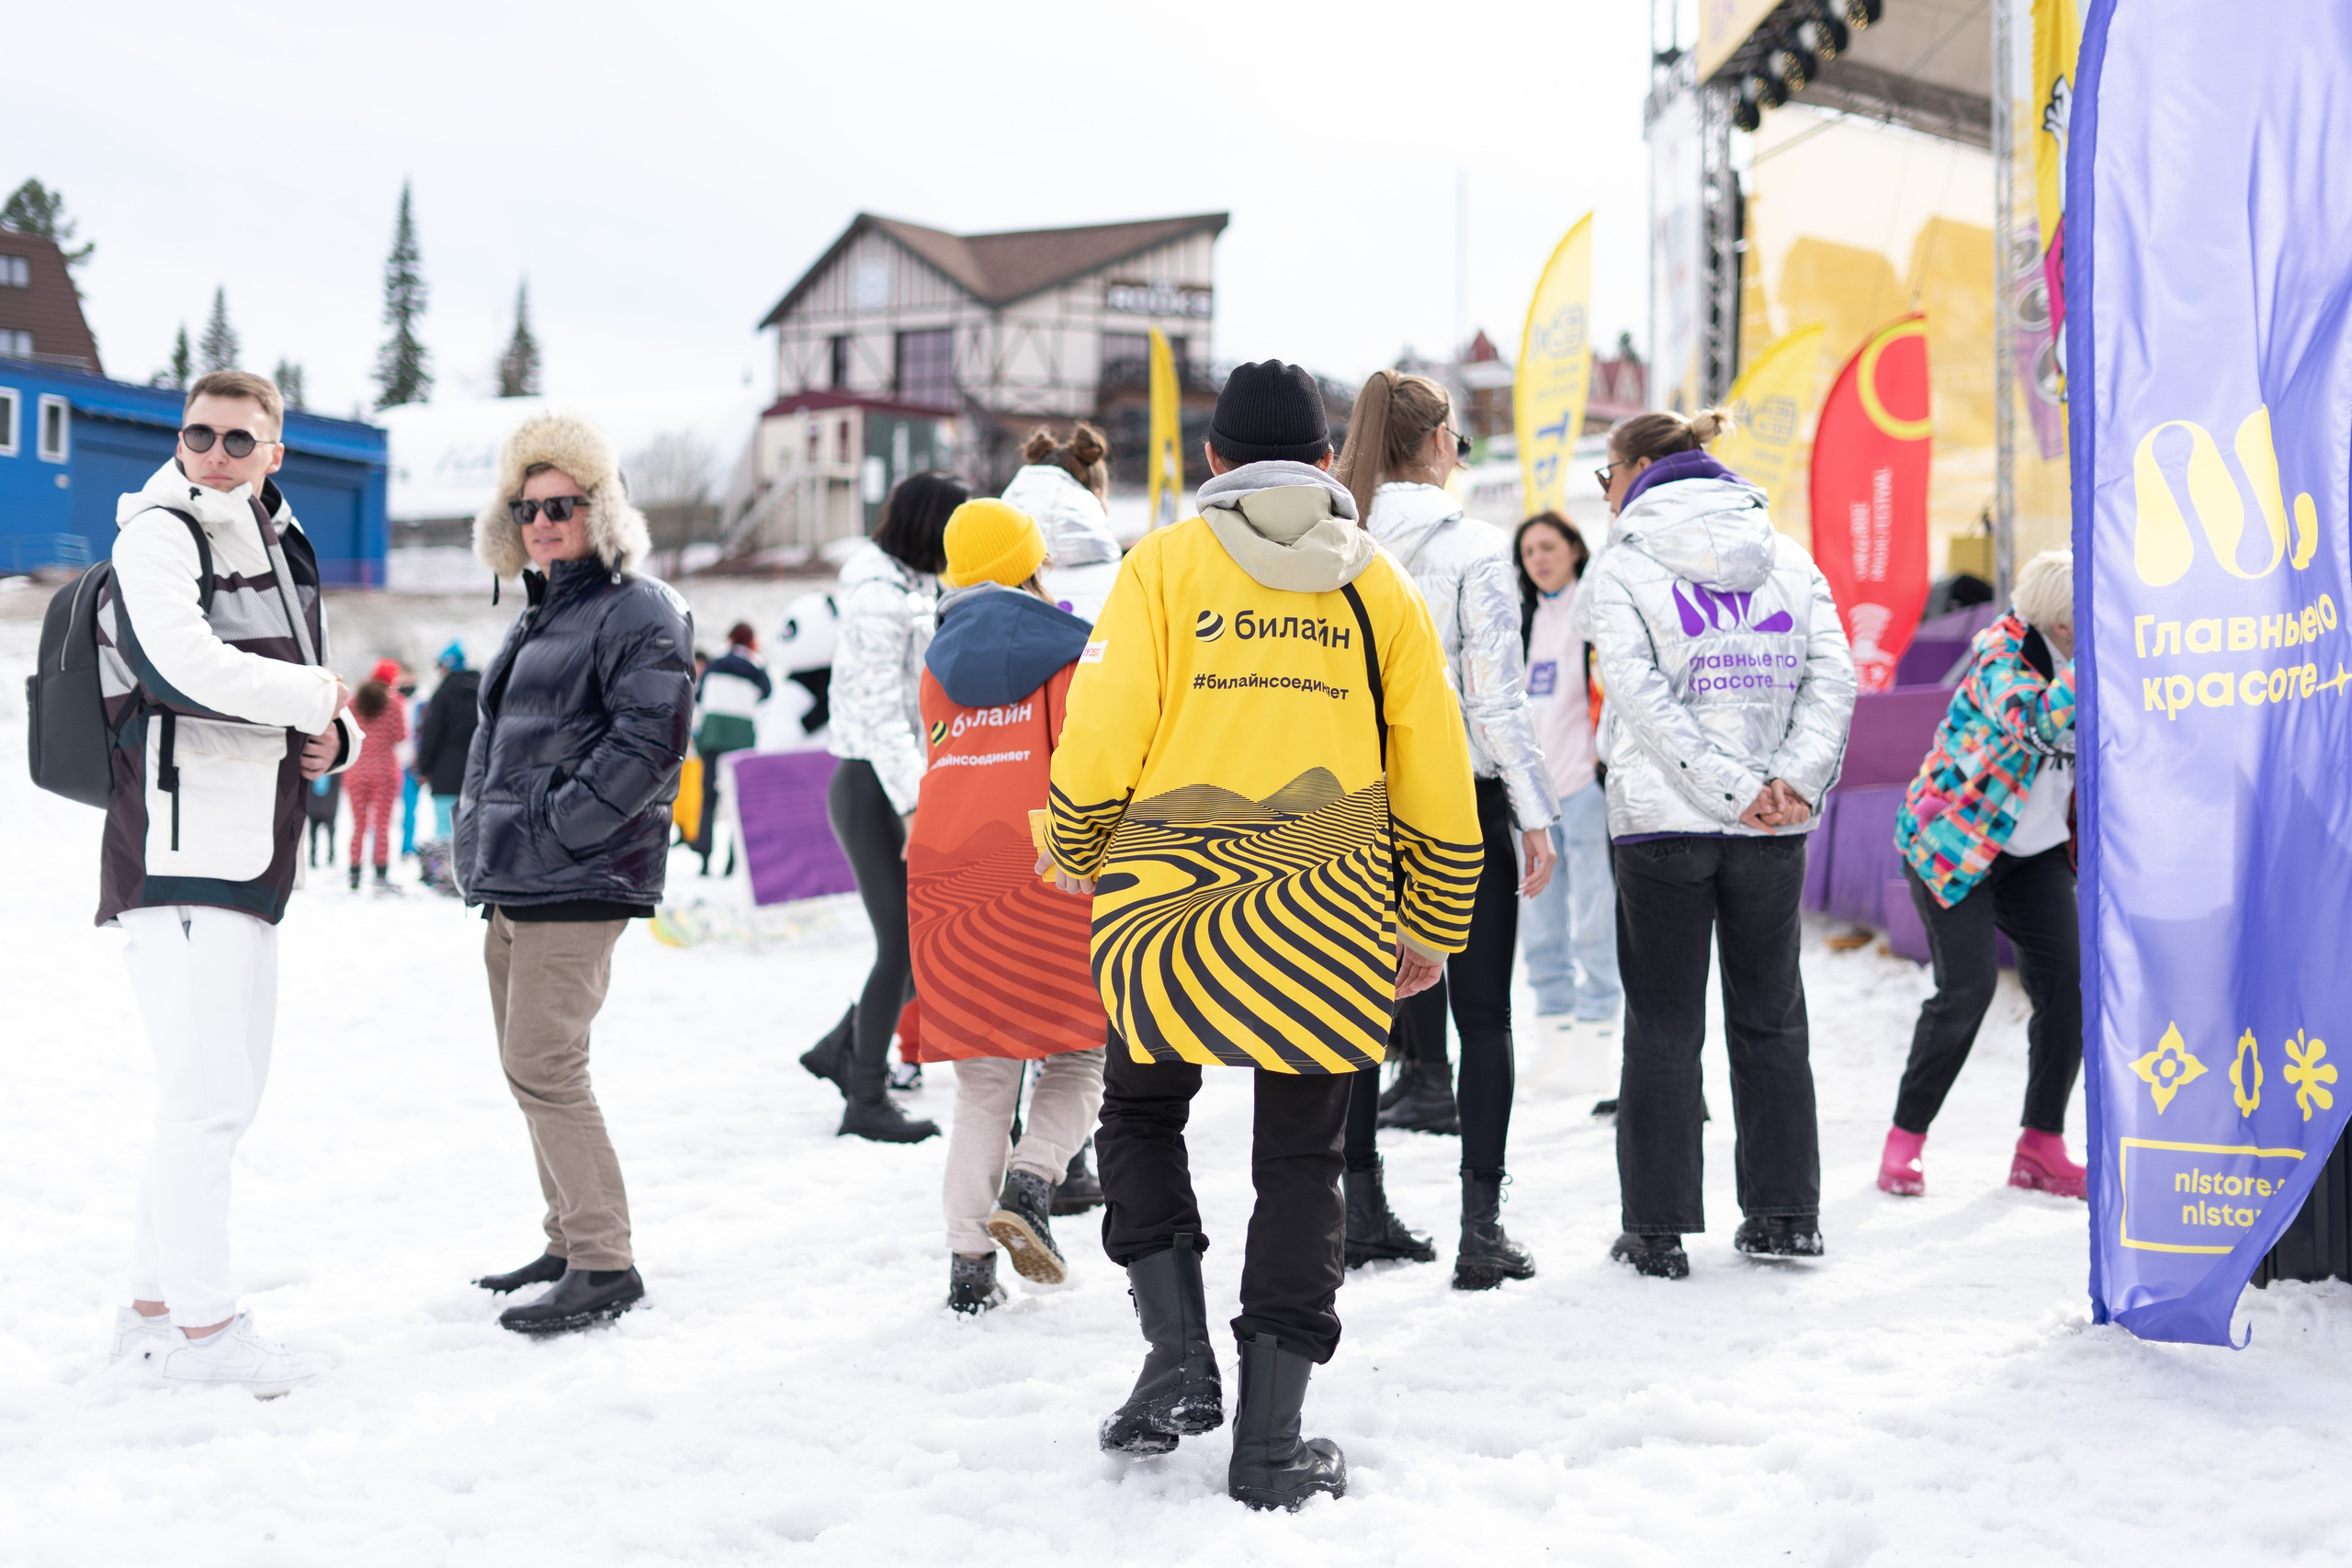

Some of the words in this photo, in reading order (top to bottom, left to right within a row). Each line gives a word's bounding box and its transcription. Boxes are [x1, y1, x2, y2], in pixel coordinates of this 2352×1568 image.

[1234, 609, 1351, 649] билайн
[2133, 605, 2317, 659] Главные
[1688, 674, 1774, 696] красоте
[2142, 662, 2318, 721] красоте
[2182, 1200, 2262, 1227] nlsta
